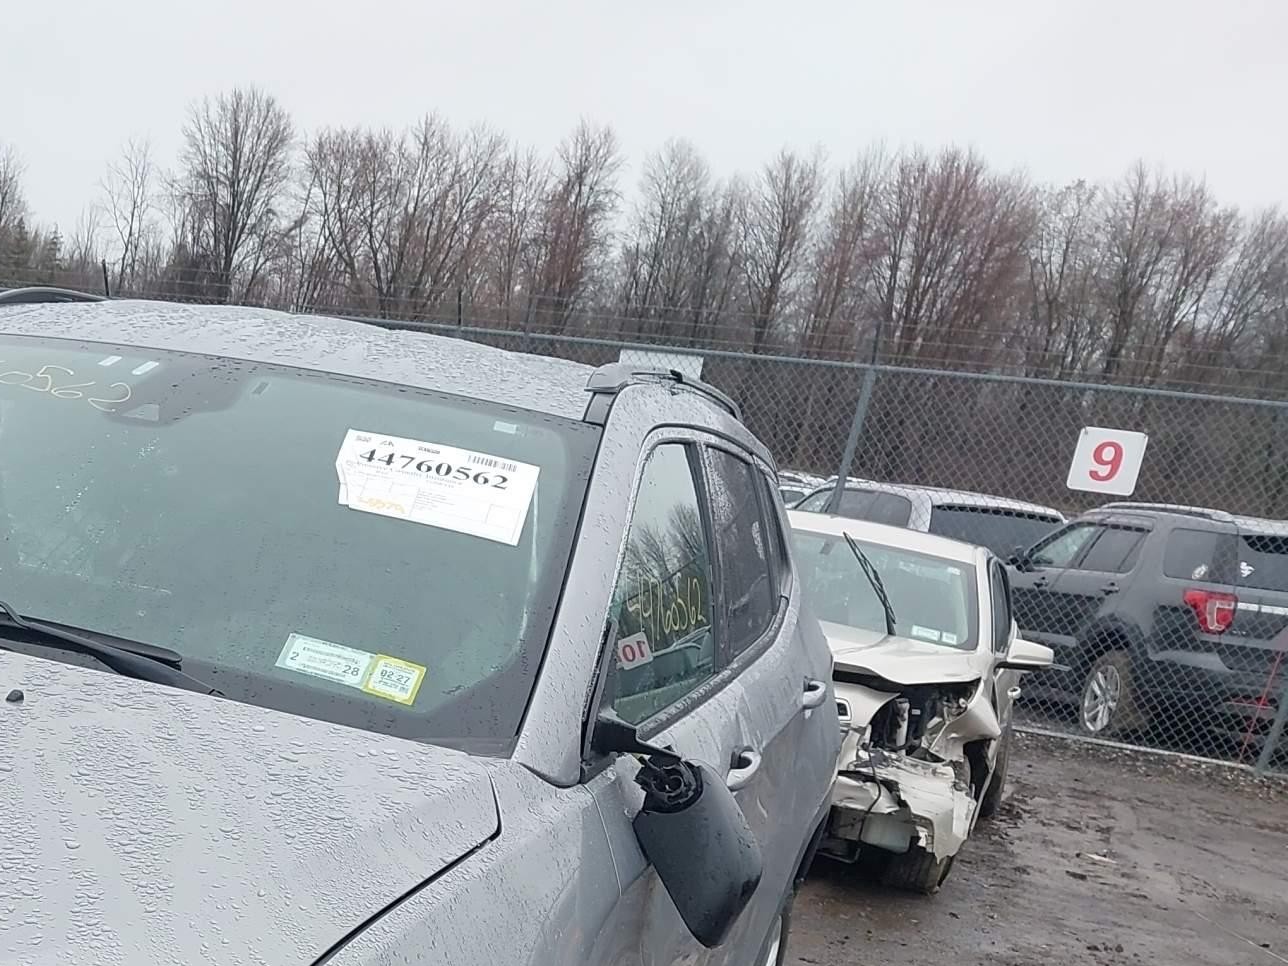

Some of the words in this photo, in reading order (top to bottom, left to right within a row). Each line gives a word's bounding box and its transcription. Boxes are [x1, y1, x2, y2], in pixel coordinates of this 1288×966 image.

[359, 448, 509, 491] 44760562
[1088, 441, 1124, 482] 9
[341, 664, 360, 677] 28
